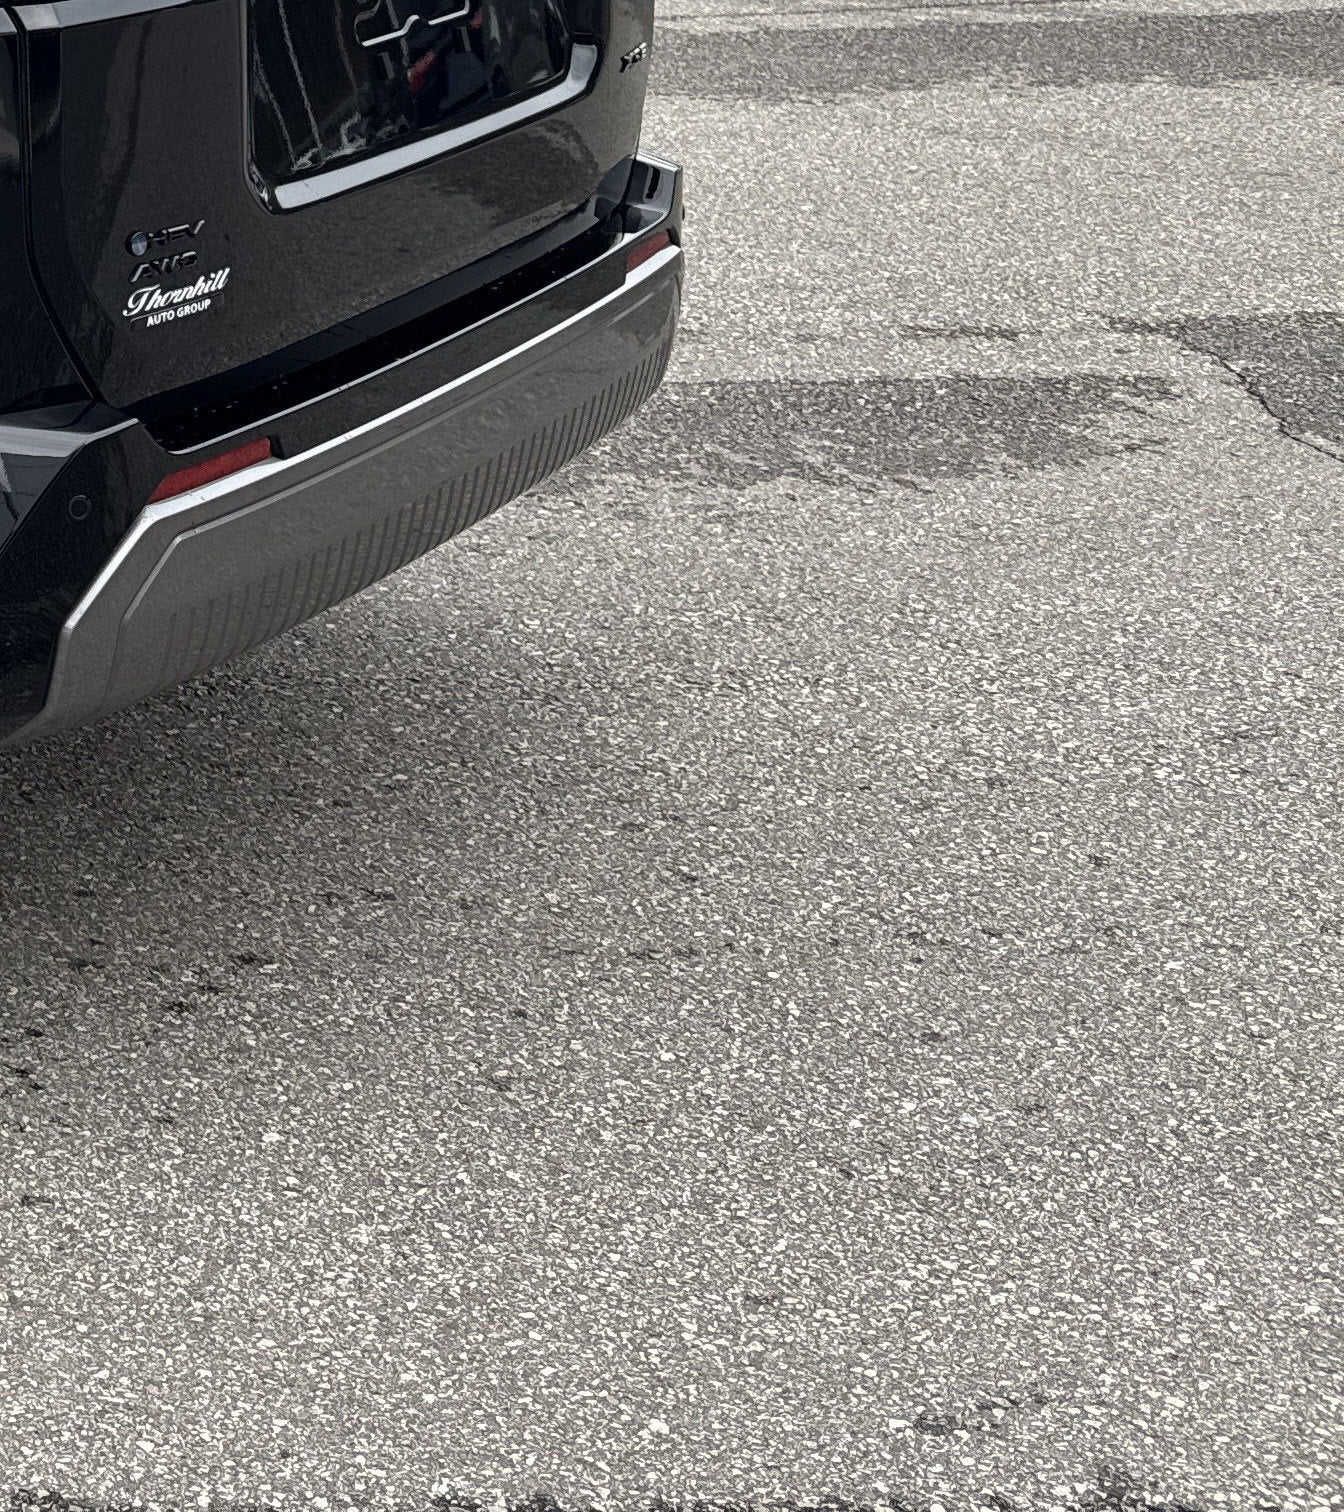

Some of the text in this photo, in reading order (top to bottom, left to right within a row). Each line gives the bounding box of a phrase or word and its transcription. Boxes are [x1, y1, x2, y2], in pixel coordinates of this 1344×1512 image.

[123, 267, 230, 316] Thornhill
[146, 299, 211, 327] AUTO GROUP
